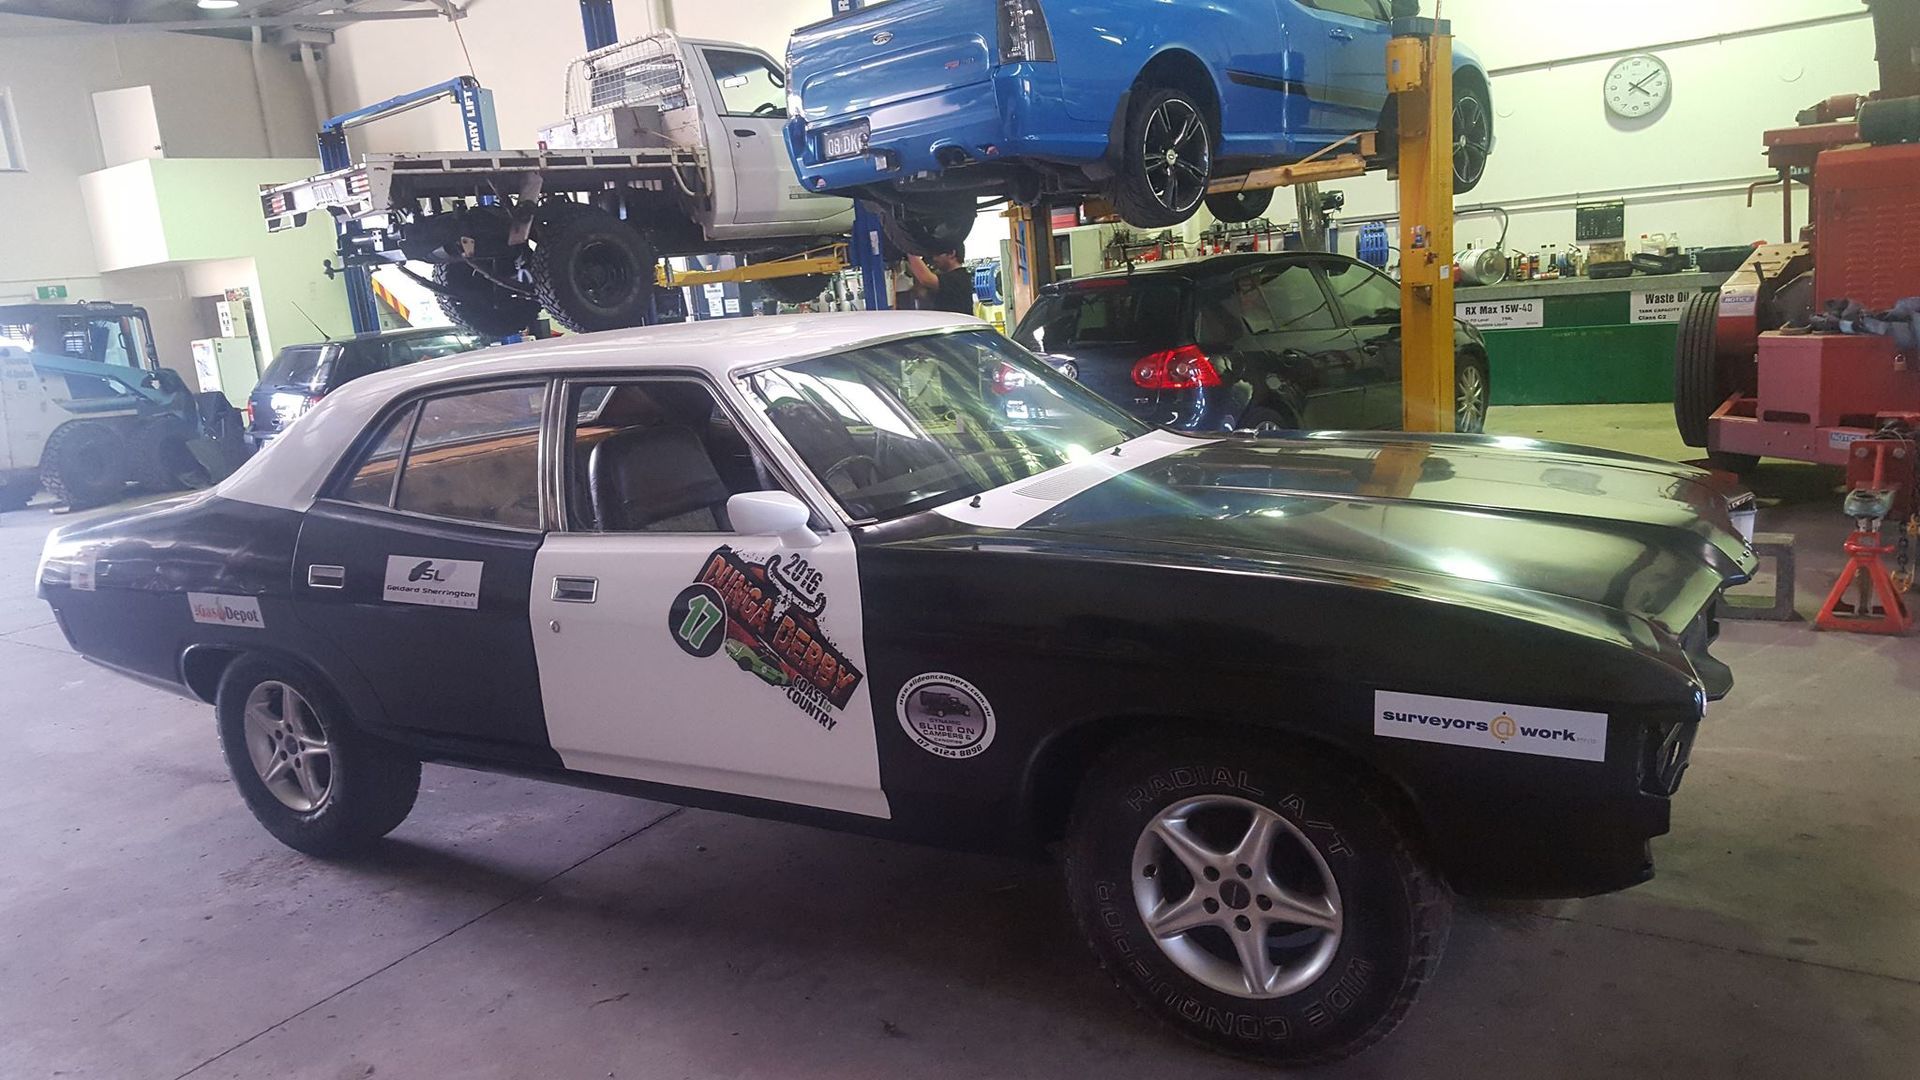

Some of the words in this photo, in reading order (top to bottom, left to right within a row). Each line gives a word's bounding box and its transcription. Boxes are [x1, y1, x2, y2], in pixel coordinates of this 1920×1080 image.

[463, 90, 476, 118] LIFT
[1465, 306, 1477, 315] RX
[1480, 305, 1498, 315] Max
[1500, 303, 1533, 314] 15W-40
[1645, 293, 1674, 304] Waste
[1677, 292, 1690, 303] Oil
[782, 553, 823, 595] 2016
[386, 584, 420, 594] Geldard
[422, 587, 476, 598] Sherrington
[701, 554, 773, 633] DUNGA
[225, 606, 259, 622] Depot
[679, 594, 723, 650] 17
[773, 615, 856, 696] DERBY
[793, 675, 828, 707] COAST
[787, 688, 837, 731] COUNTRY
[919, 722, 953, 732] SLIDE
[957, 726, 975, 735] ON
[923, 730, 964, 740] CAMPERS
[916, 738, 930, 747] 07
[932, 746, 956, 756] 4124
[959, 744, 983, 757] 8898
[1127, 766, 1264, 811] RADIAL
[1279, 793, 1352, 857] A/T
[1304, 956, 1372, 1027] WIDE
